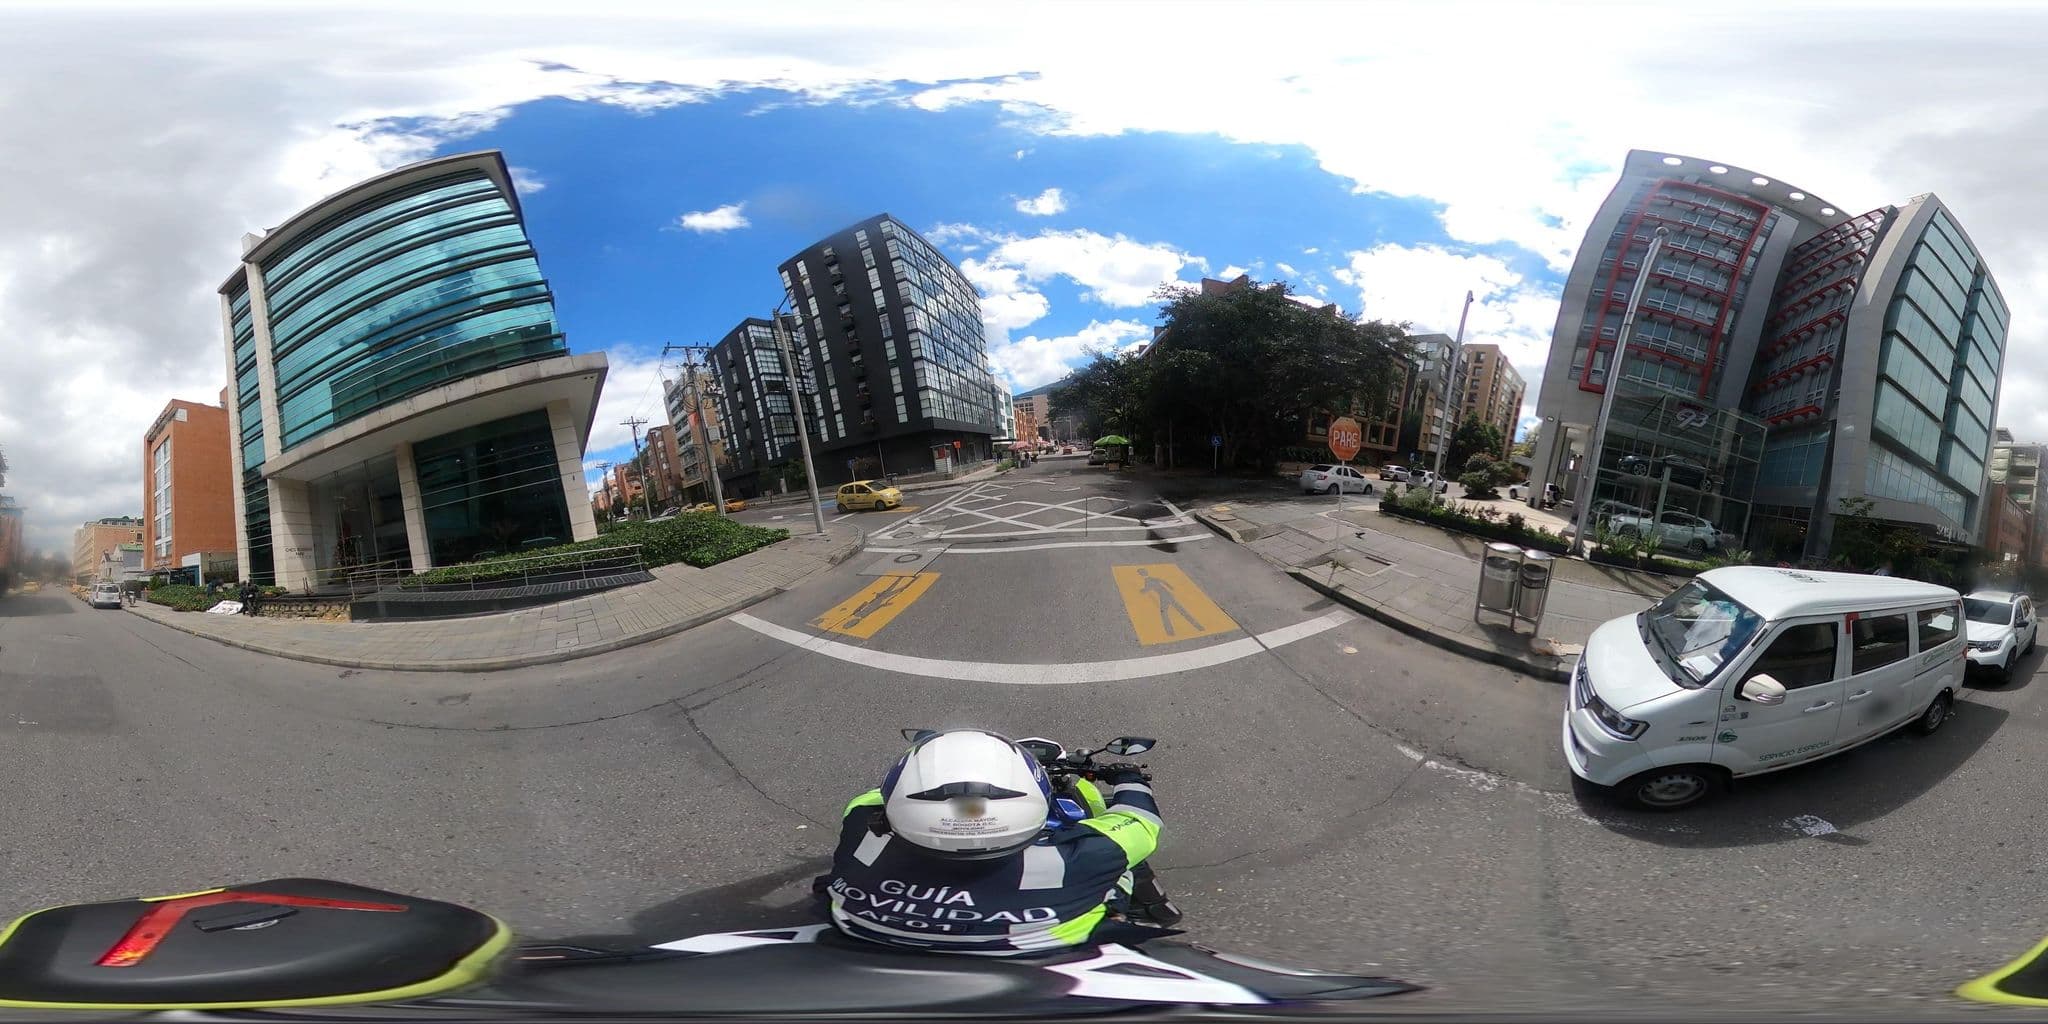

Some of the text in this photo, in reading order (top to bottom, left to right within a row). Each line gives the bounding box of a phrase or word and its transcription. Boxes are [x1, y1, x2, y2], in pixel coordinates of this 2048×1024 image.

[1333, 430, 1360, 448] PARE
[1759, 740, 1830, 761] SERVICIO ESPECIAL
[832, 877, 1058, 923] MOVILIDAD
[879, 879, 976, 906] GUÍA
[856, 909, 951, 932] AF01
